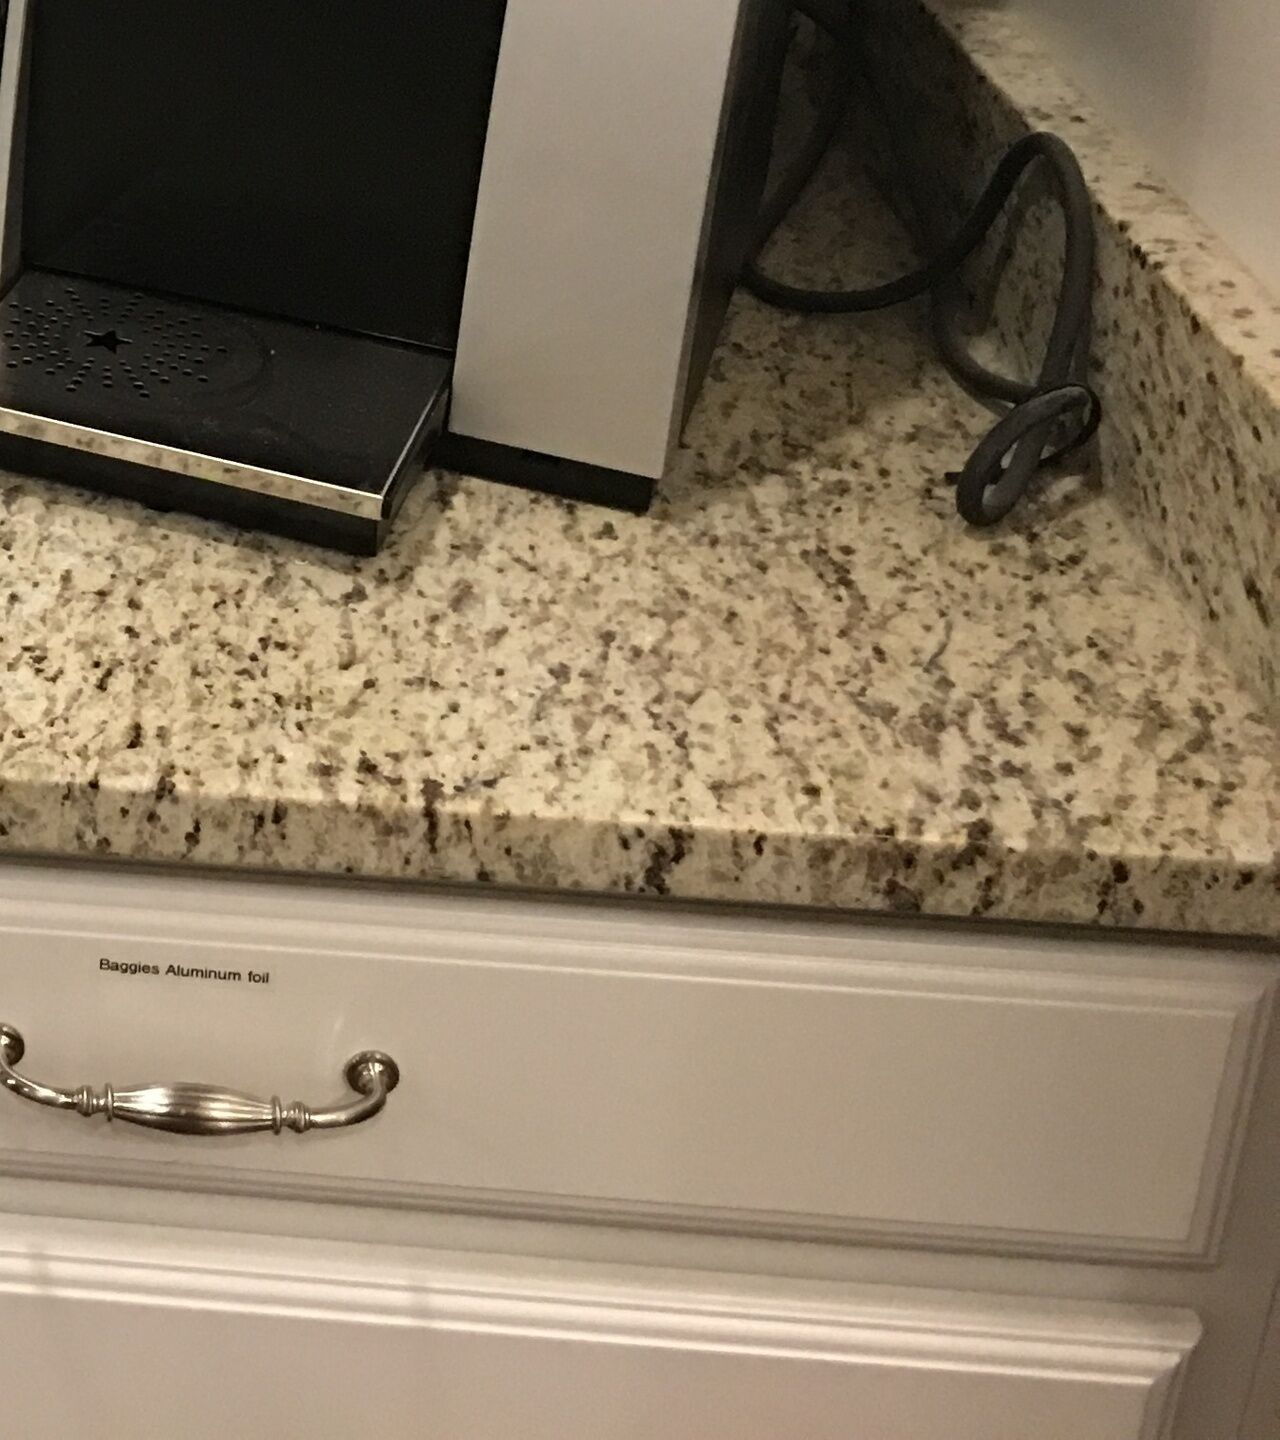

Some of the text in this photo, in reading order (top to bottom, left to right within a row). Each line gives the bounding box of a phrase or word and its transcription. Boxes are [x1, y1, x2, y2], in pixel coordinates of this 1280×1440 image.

[99, 958, 270, 984] Baggies Aluminum foil
